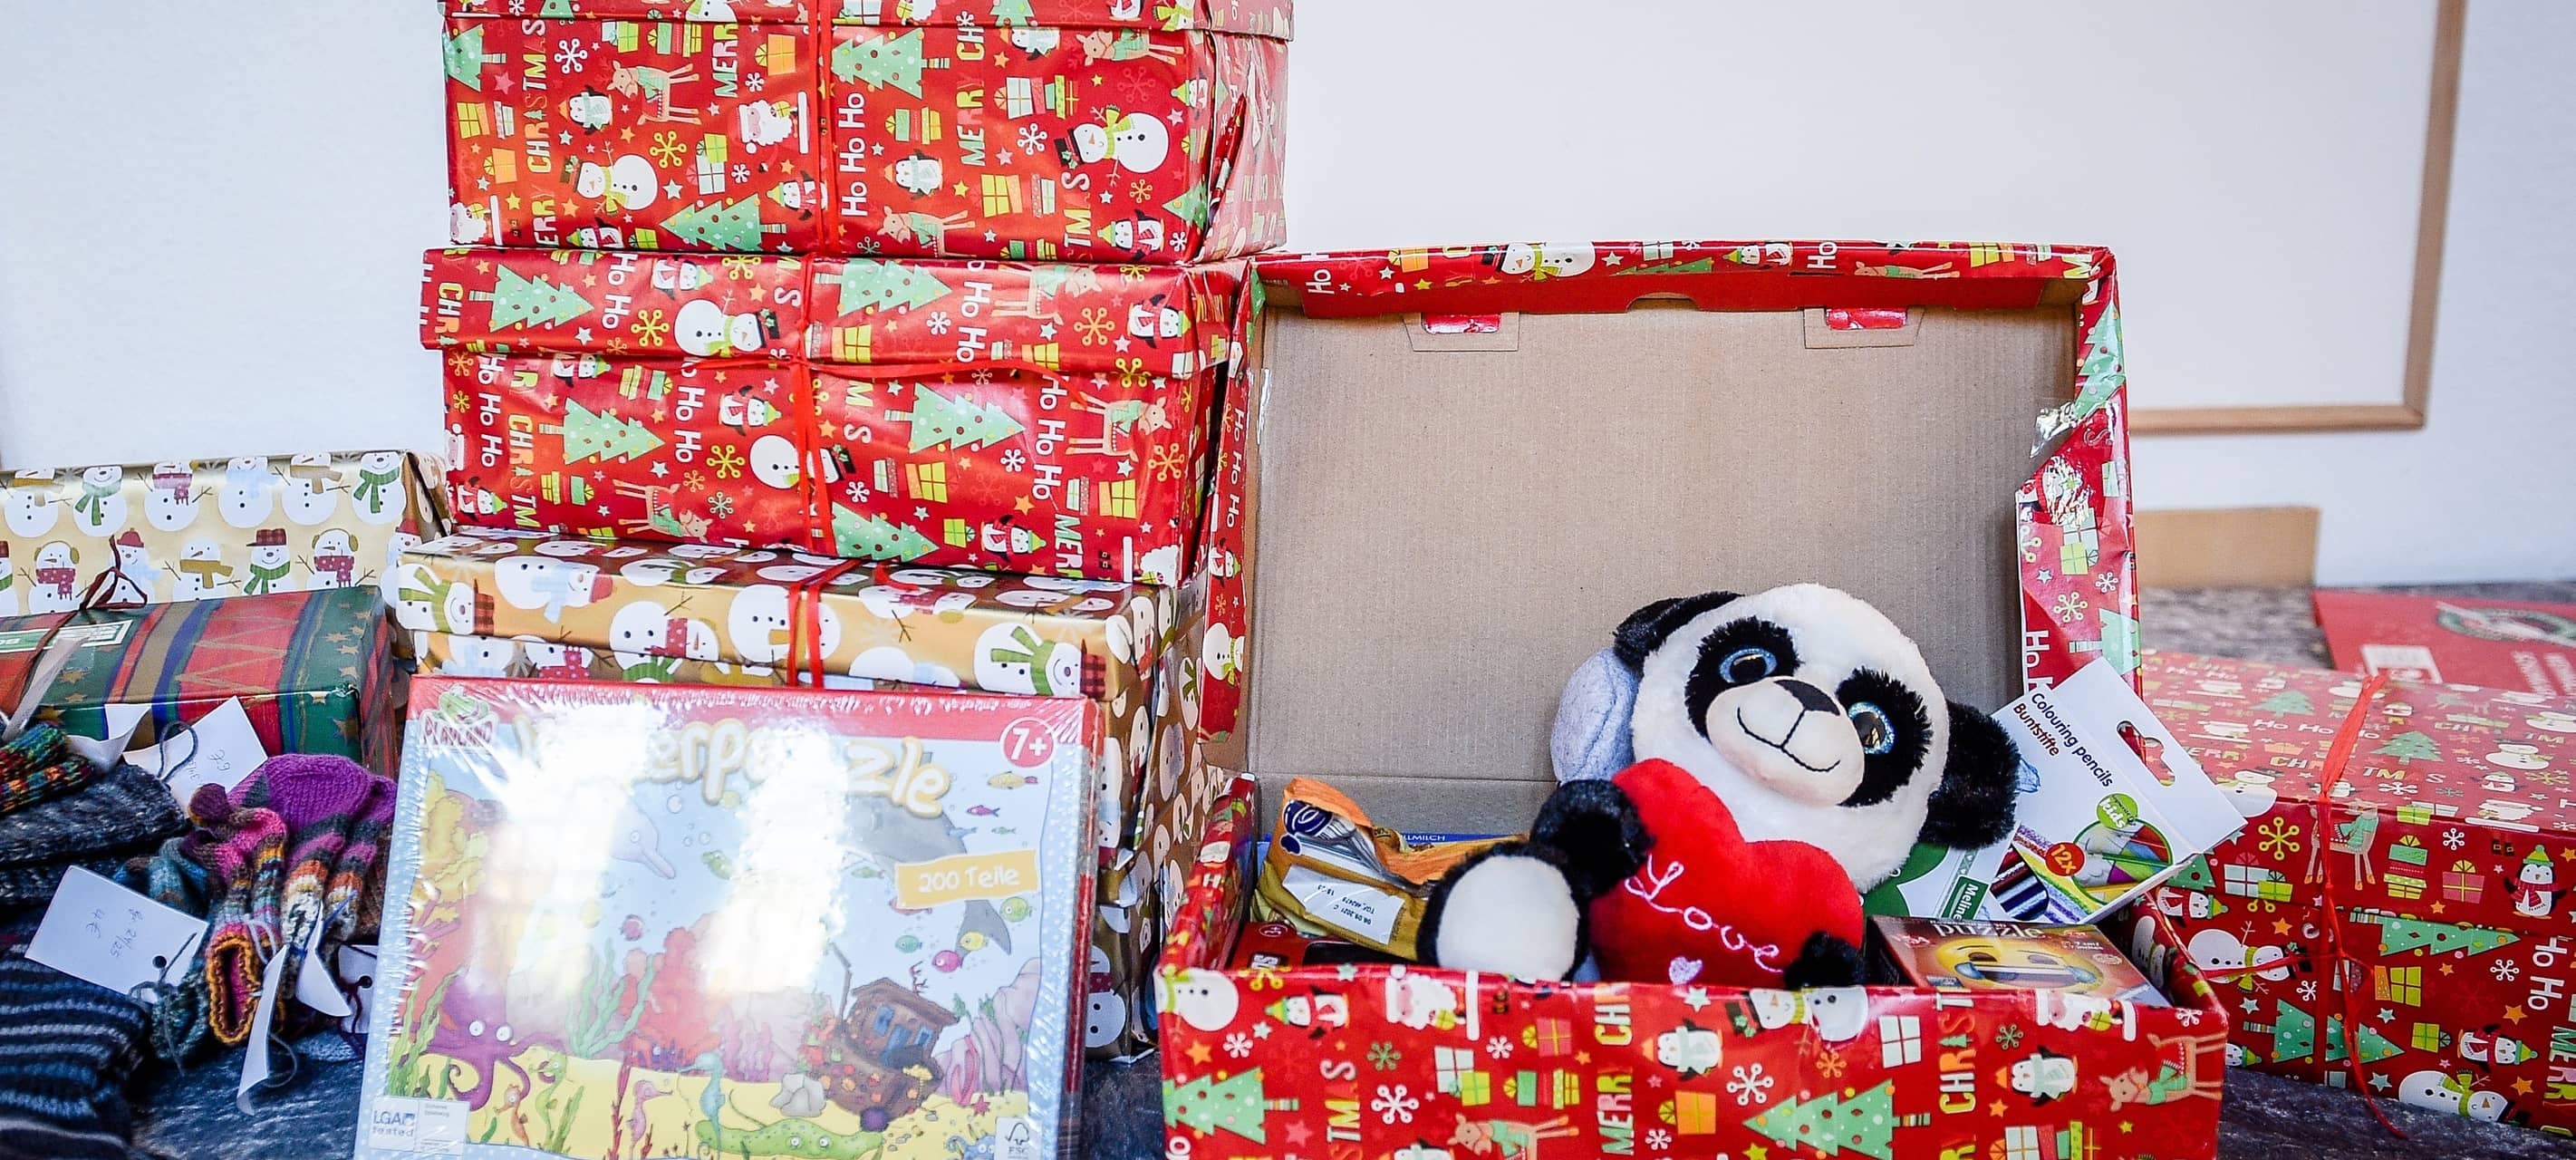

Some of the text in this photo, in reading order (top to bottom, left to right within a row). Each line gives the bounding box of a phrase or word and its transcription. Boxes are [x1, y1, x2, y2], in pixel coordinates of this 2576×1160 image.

[838, 92, 867, 217] Ho Ho Ho
[531, 185, 560, 246] ERRY
[1806, 241, 1838, 270] Ho
[601, 253, 638, 330] Ho Ho
[960, 280, 993, 318] Ho
[1306, 268, 1336, 295] Ho
[955, 325, 988, 363] Ho
[478, 354, 506, 468] Ho Ho Ho
[675, 386, 706, 421] Ho
[675, 429, 702, 464] Ho
[1032, 372, 1069, 501] Ho Ho Ho
[1226, 410, 1245, 528] Ho Ho Ho
[1011, 728, 1048, 759] 7+
[2012, 702, 2060, 758] Buntstifte
[2031, 691, 2078, 749] Colouring
[2072, 745, 2113, 788] pencils
[2253, 719, 2289, 730] Ho
[2298, 723, 2334, 735] Ho
[2098, 798, 2127, 828] kids
[2050, 845, 2079, 875] 12x
[918, 864, 1022, 894] 200 Teile
[1624, 854, 1784, 973] Love
[1933, 922, 2046, 941] puzzle
[2528, 975, 2565, 1011] Ho
[371, 1125, 414, 1138] tested
